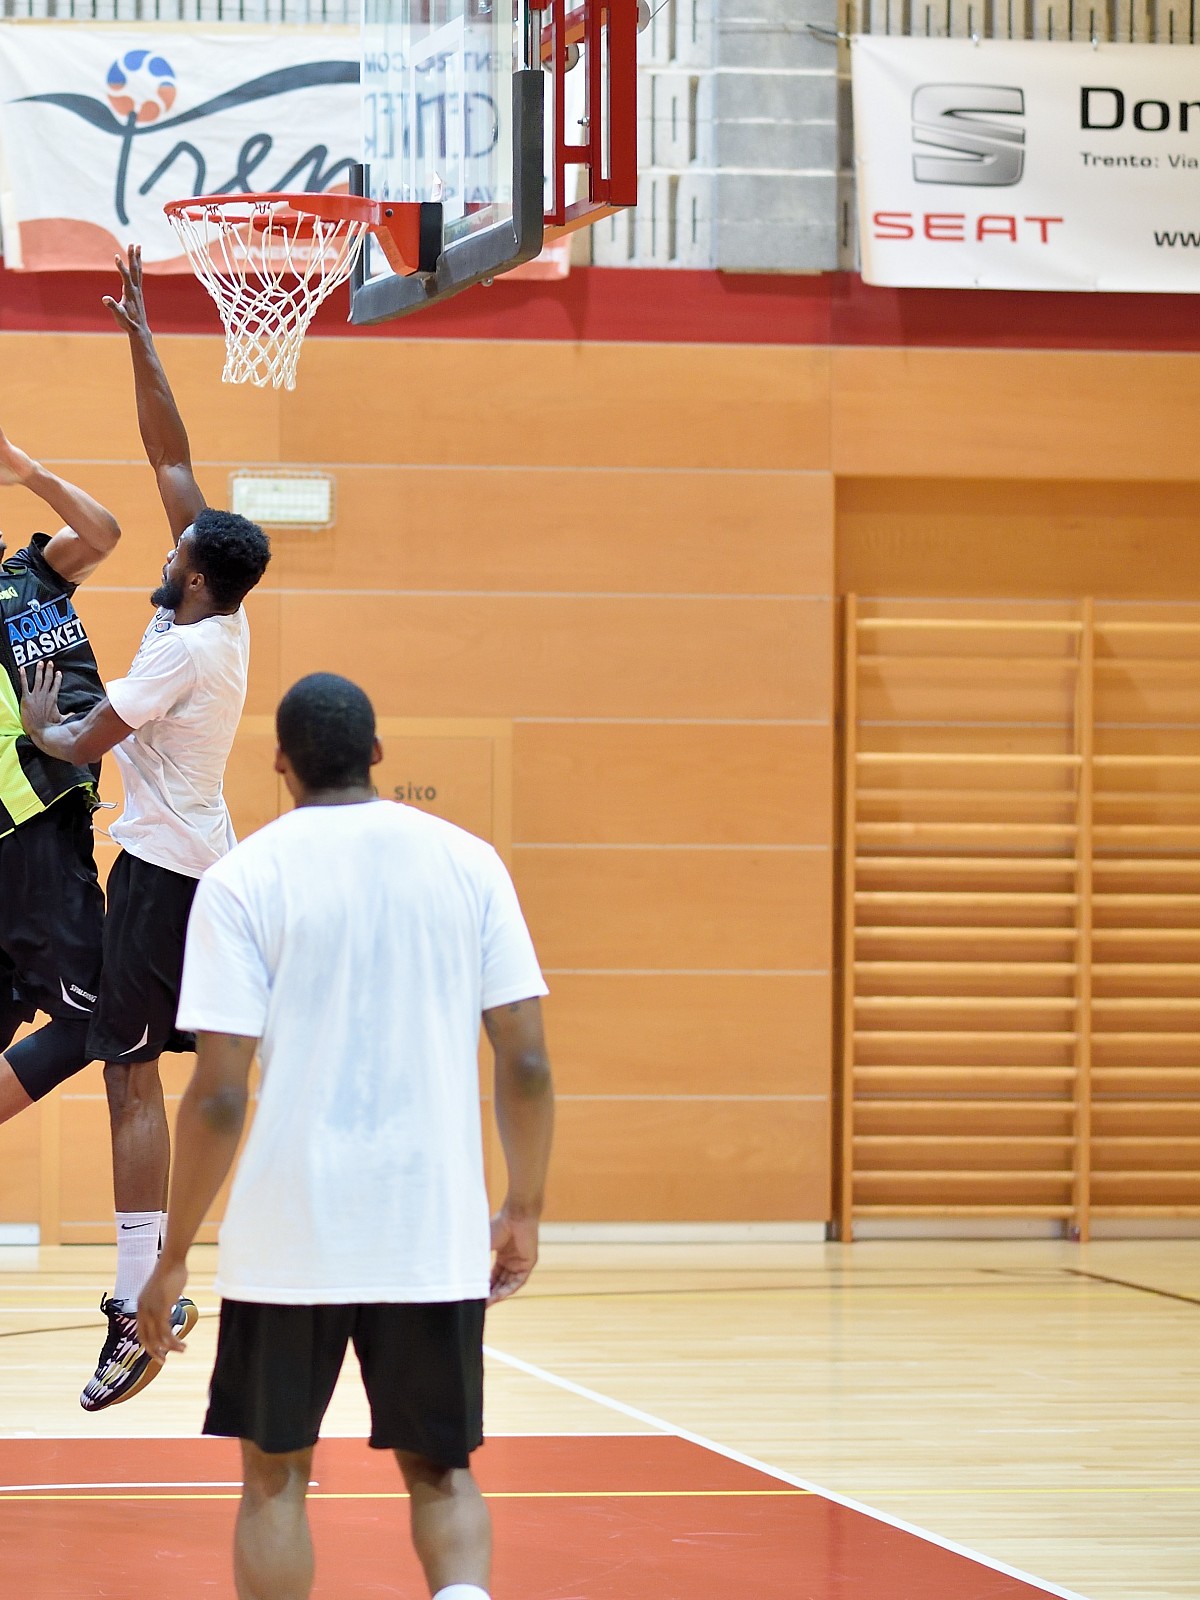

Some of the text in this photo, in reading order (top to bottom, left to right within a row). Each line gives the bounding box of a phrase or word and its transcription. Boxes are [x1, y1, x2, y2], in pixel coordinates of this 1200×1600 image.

[1081, 152, 1199, 169] Trento: Via
[872, 211, 1065, 245] SEAT
[7, 597, 77, 647] AQUILA
[11, 618, 85, 667] BASKET
